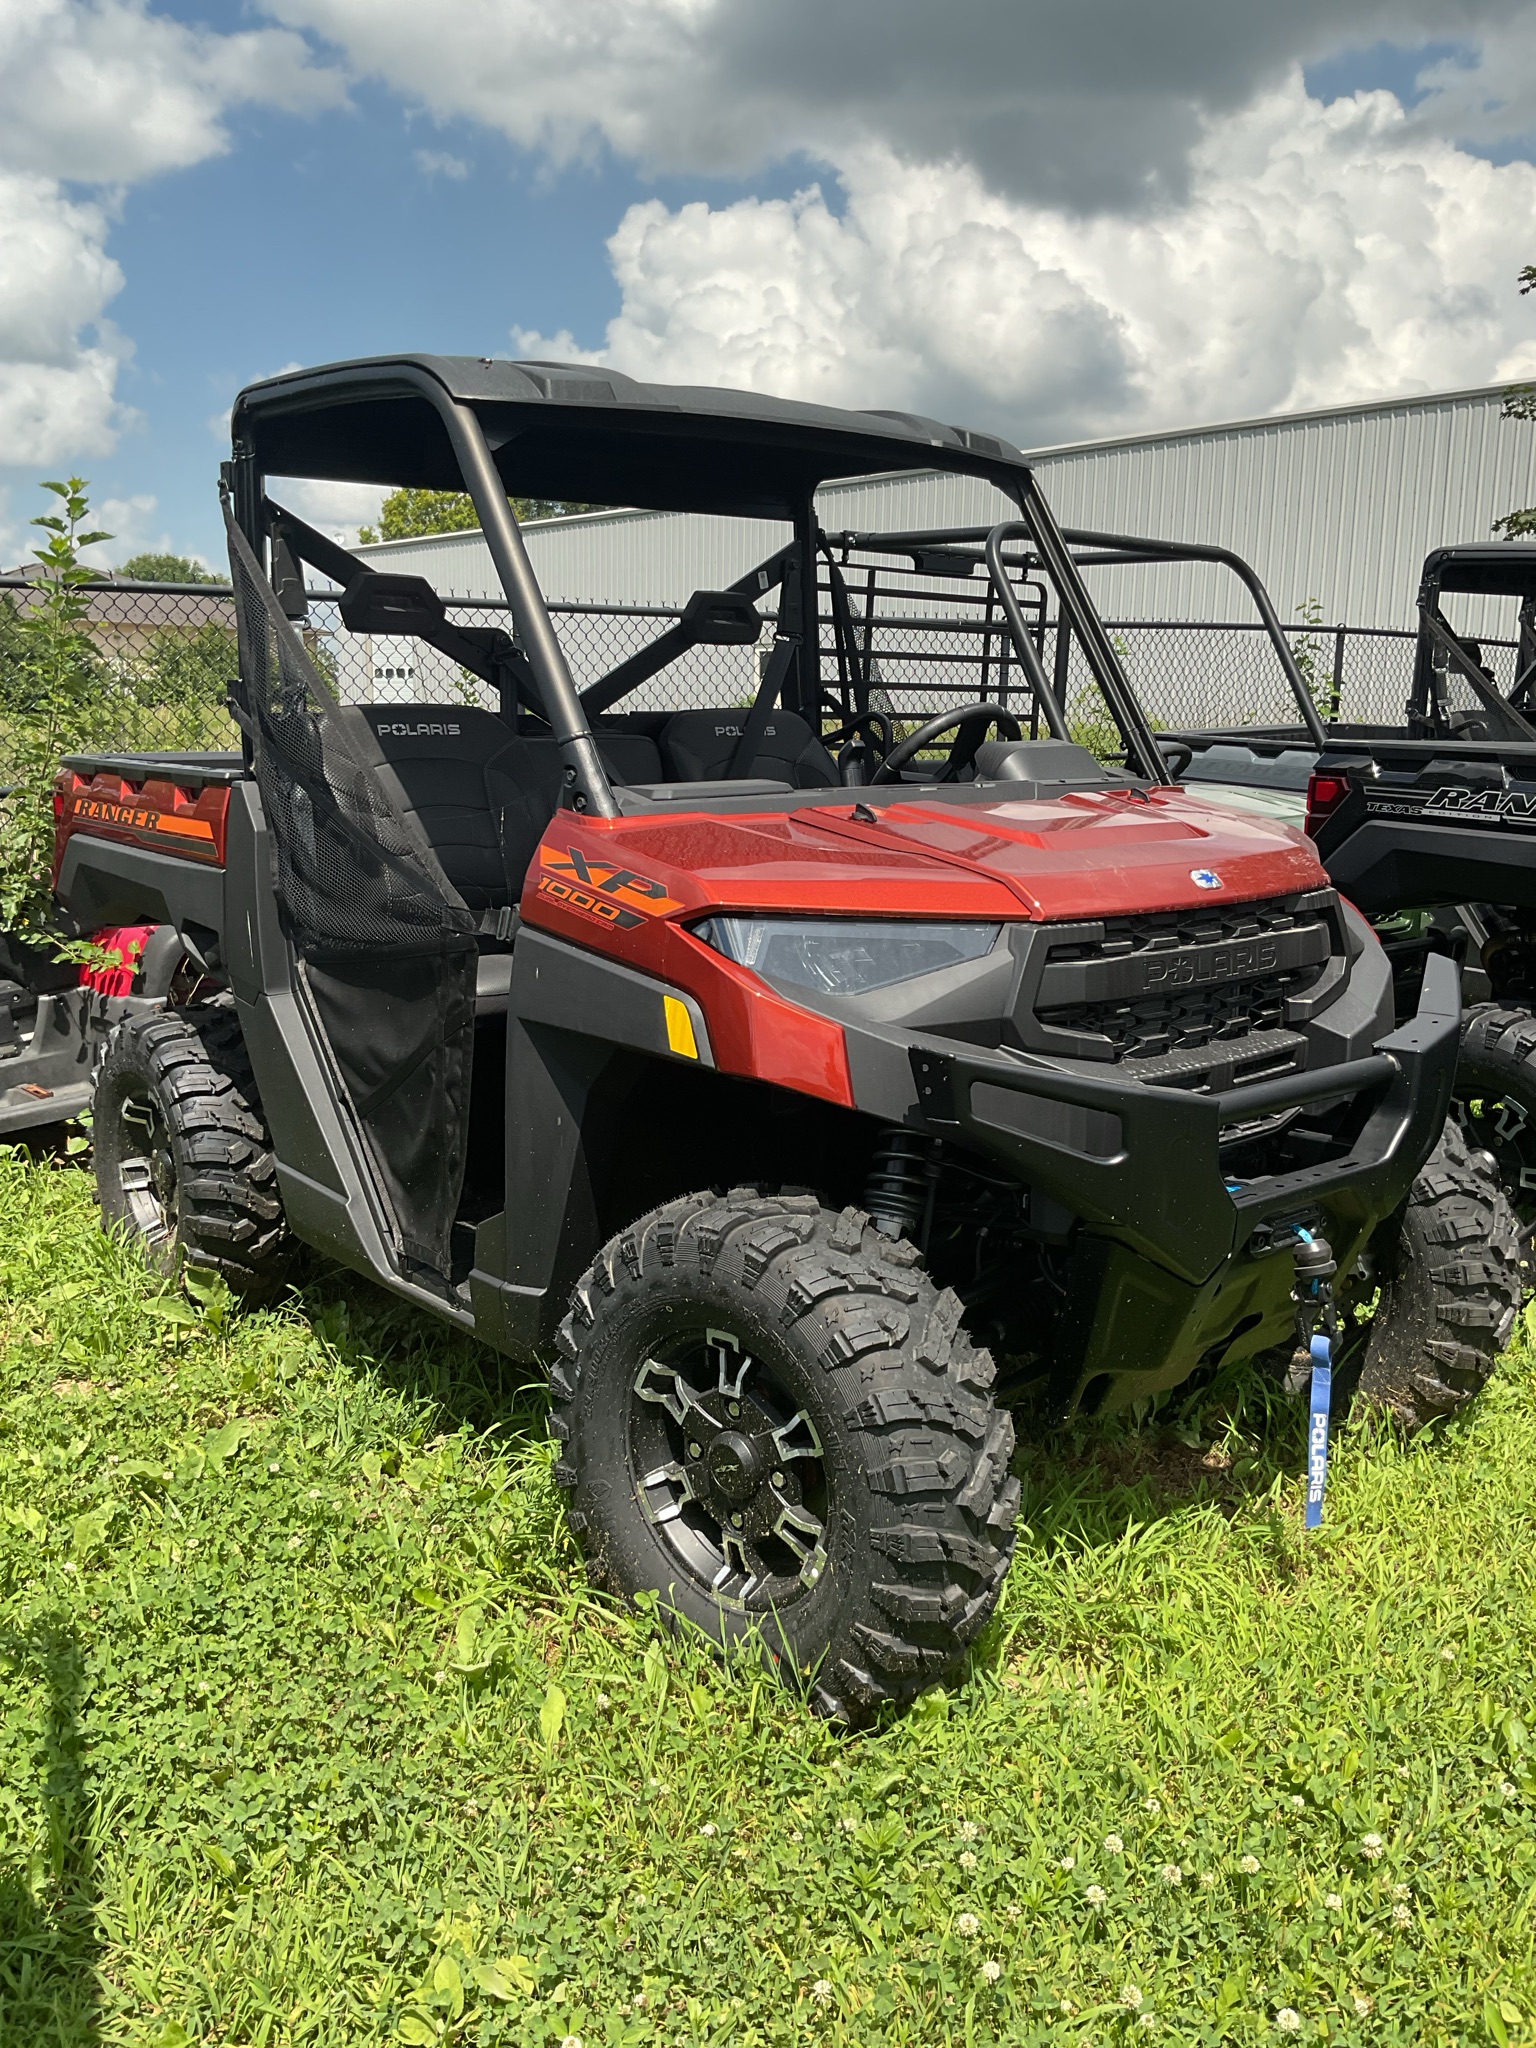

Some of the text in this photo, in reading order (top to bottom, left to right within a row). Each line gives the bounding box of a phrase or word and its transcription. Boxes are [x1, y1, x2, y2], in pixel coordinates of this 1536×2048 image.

[377, 723, 461, 737] POLARIS
[78, 799, 161, 832] RANGER
[1366, 802, 1493, 820] TEXAS EDITION
[543, 845, 669, 899] XP
[538, 877, 621, 921] 1000
[1142, 941, 1277, 989] POLARIS
[1309, 1413, 1327, 1503] POLARIS
